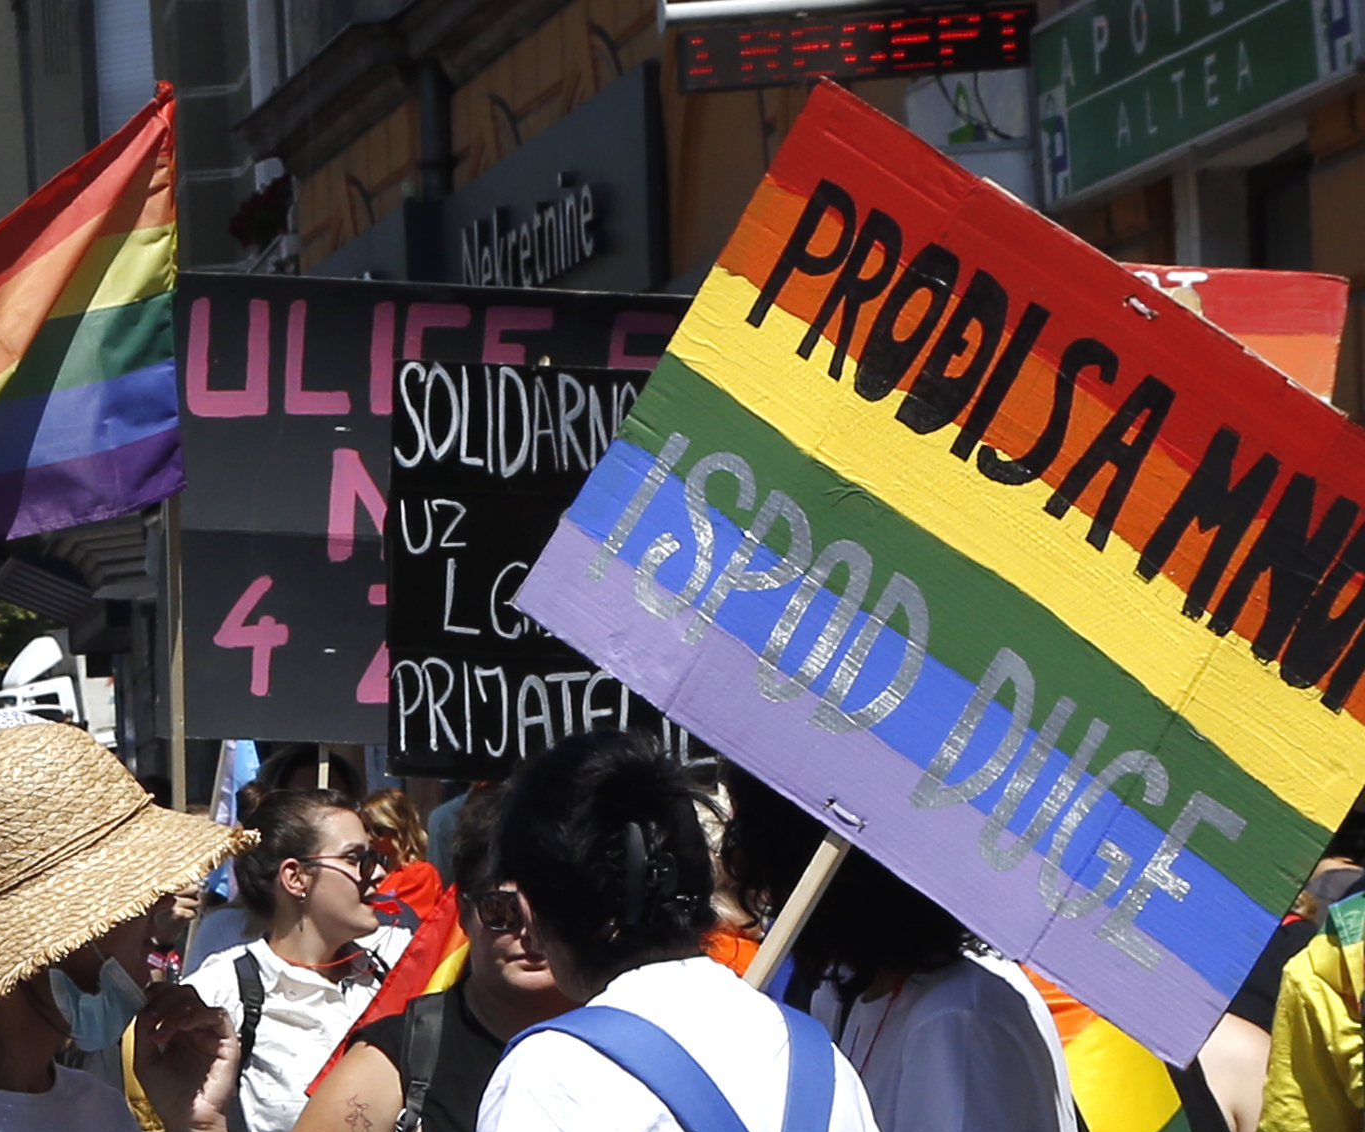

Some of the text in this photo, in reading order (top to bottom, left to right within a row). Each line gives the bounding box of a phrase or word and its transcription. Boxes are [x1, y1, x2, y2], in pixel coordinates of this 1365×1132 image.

[1117, 40, 1253, 149] ALTEA
[462, 172, 594, 289] Nekretnine
[399, 499, 468, 554] UZ
[584, 431, 1248, 974] ISPOD DUGE
